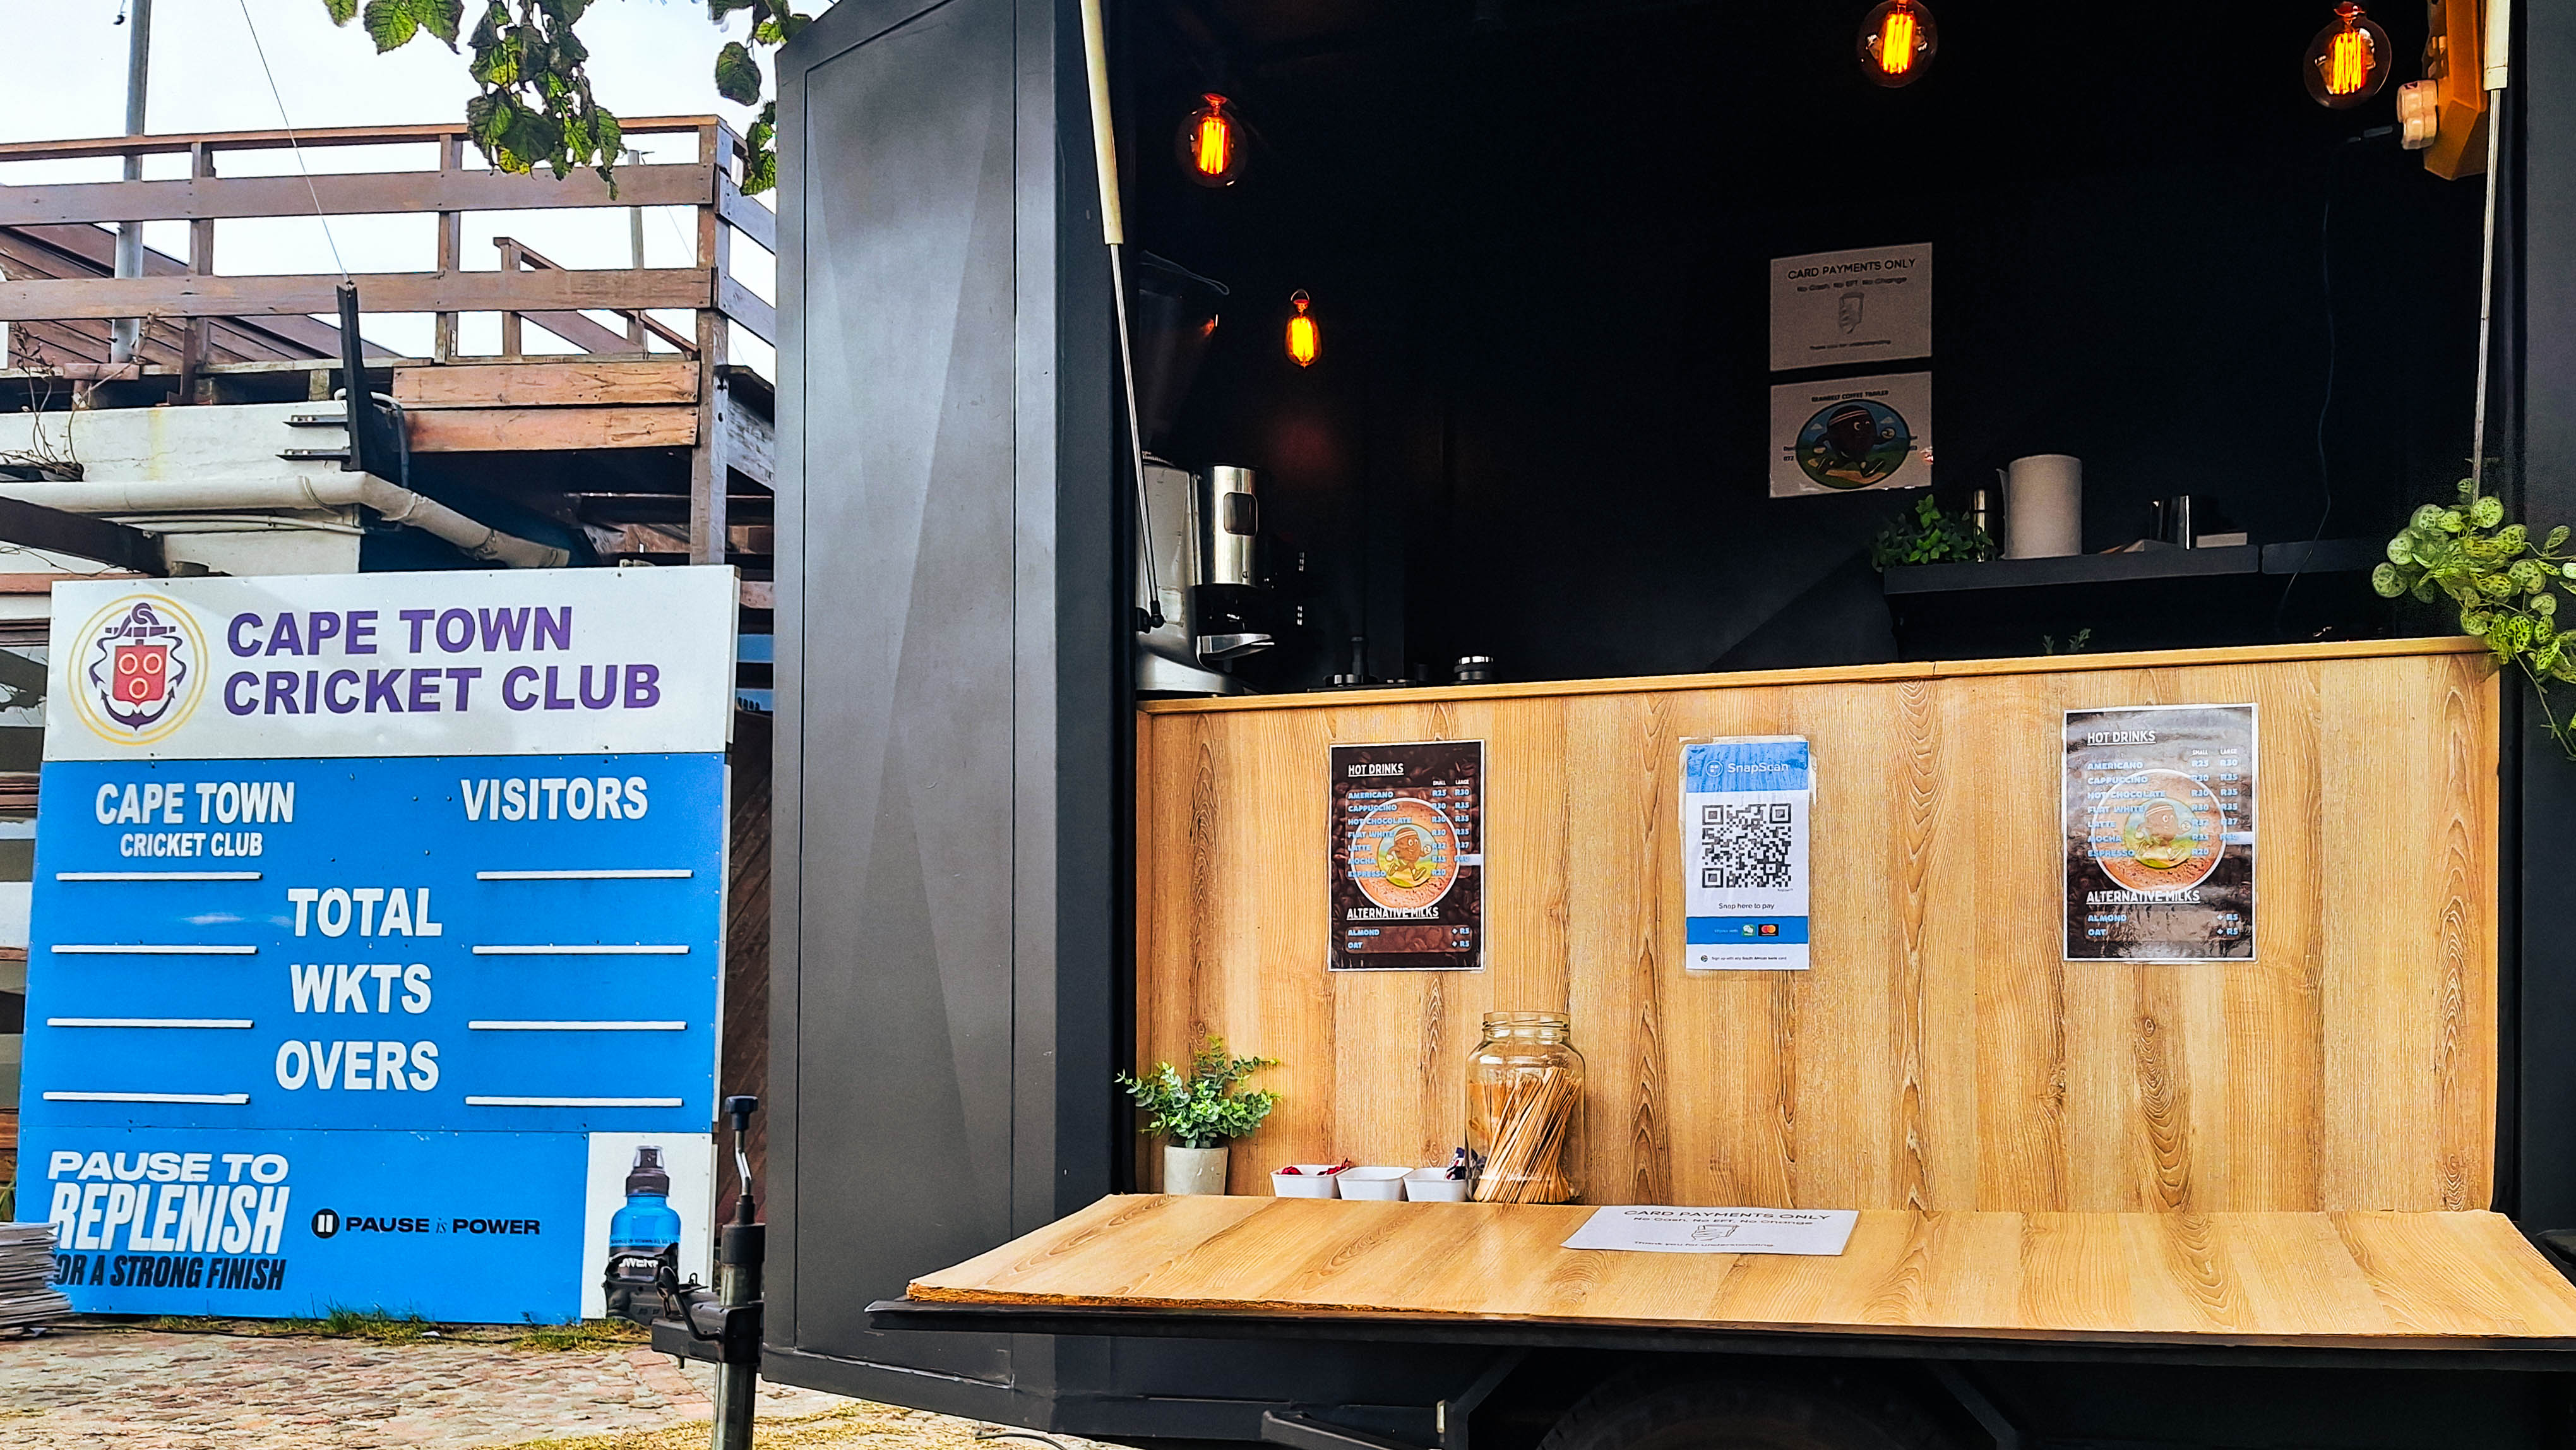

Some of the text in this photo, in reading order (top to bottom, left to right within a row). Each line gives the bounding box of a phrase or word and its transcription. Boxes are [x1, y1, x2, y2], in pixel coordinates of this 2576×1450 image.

[1788, 258, 1916, 279] CARD PAYMENTS ONLY
[227, 606, 572, 657] CAPE TOWN
[224, 664, 660, 716] CRICKET CLUB
[2087, 731, 2156, 743] HOT DRINKS
[1348, 764, 1404, 775] HOT DRINKS
[1727, 763, 1789, 773] SnapScan
[2087, 758, 2238, 770] AMERICANO R25 R30
[2088, 776, 2148, 784] CAPPUCCINO
[2221, 773, 2238, 781] R35
[95, 782, 294, 824] CAPE TOWN
[461, 777, 648, 820] VISITORS
[2111, 790, 2166, 798] CHOCOLATE
[2087, 806, 2110, 814] FLAT
[2114, 805, 2145, 813] WHITE
[2221, 803, 2238, 811] R35
[120, 832, 263, 858] CRICKET CLUB
[2087, 890, 2200, 903] ALTERNATIVE MILKS
[288, 887, 442, 937] TOTAL
[1347, 907, 1439, 919] ALTERNATIVE MILKS
[2088, 928, 2106, 937] OAT
[290, 964, 431, 1014] WKTS
[275, 1040, 439, 1091] OVERS
[48, 1151, 289, 1184] PAUSE TO
[48, 1182, 290, 1254] REPLENISH
[346, 1216, 540, 1235] PAUSE is POWER
[54, 1254, 286, 1290] OR A STRONG FINISH
